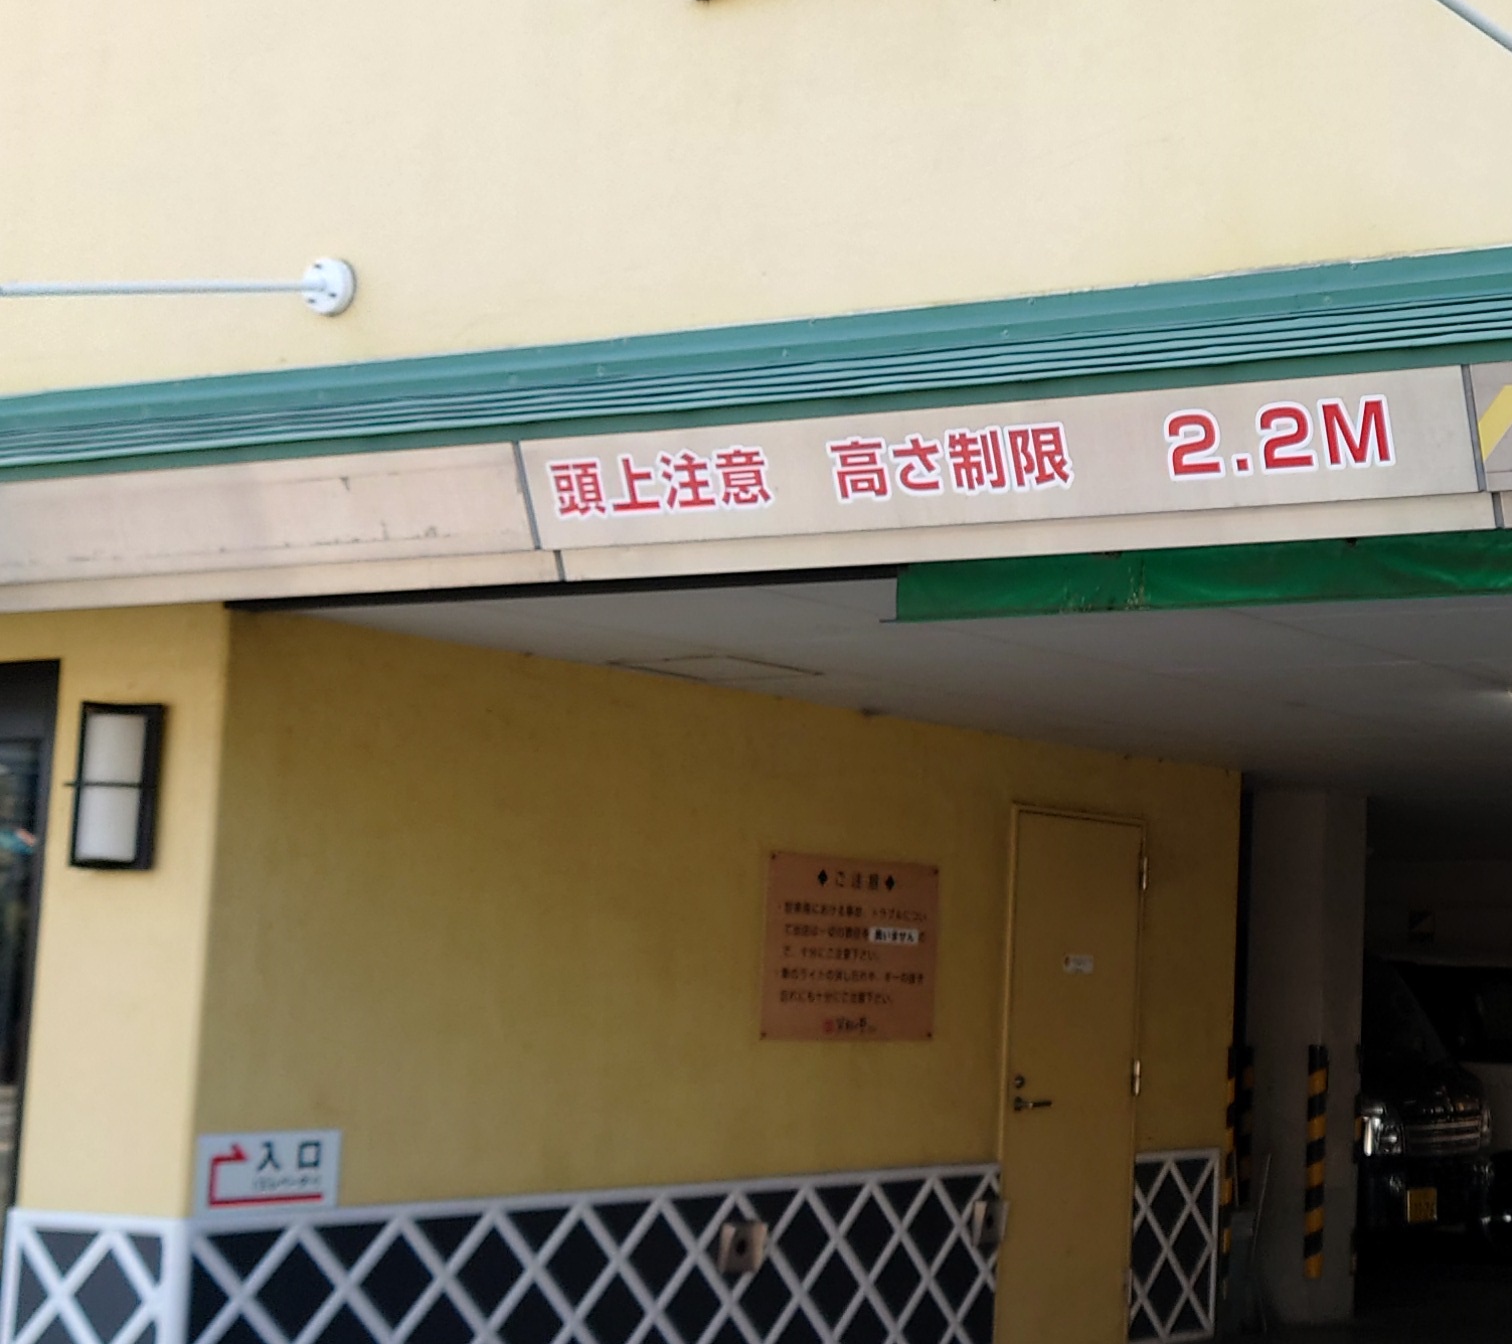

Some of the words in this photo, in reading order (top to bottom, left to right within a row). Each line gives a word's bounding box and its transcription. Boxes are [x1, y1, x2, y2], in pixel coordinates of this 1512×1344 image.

[551, 446, 771, 519] 頭上注意
[830, 421, 1074, 501] 高さ制限
[1166, 395, 1392, 479] 2.2M
[257, 1140, 321, 1171] 入口
